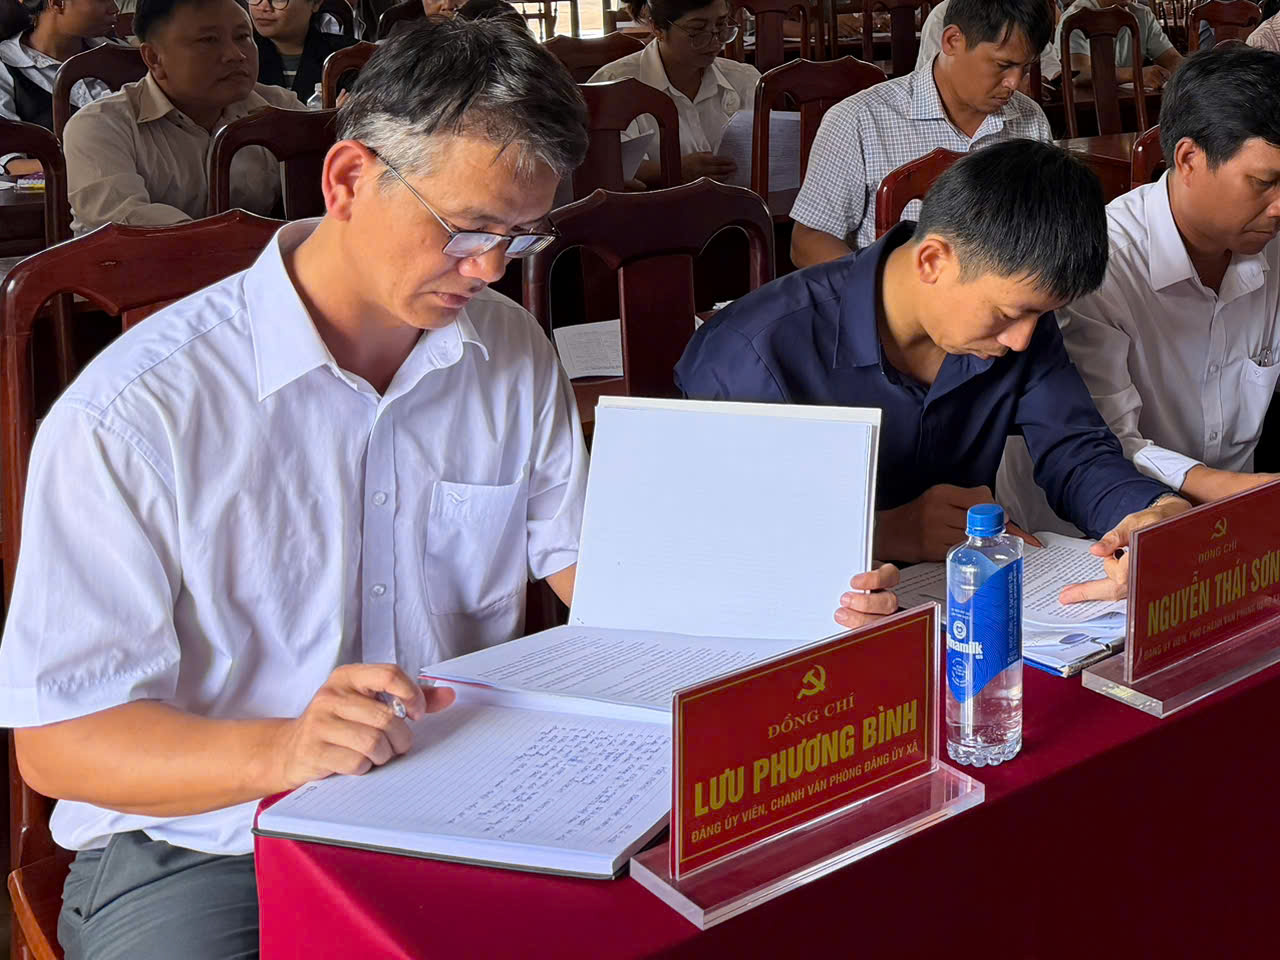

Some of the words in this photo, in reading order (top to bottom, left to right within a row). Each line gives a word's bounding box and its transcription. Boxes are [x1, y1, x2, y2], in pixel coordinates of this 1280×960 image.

[1147, 570, 1211, 638] NGUYỄN
[1215, 558, 1247, 609] THÁI
[1250, 549, 1280, 593] SƠN
[694, 766, 745, 818] LƯU
[753, 724, 856, 795] PHƯƠNG
[862, 698, 918, 751] BÌNH
[767, 707, 820, 739] ĐỒNG
[824, 691, 855, 717] CHÍ
[691, 822, 721, 844] ĐẢNG
[742, 803, 768, 823] VIÊN,
[829, 765, 862, 787] PHÒNG
[864, 753, 890, 772] ĐẢNG
